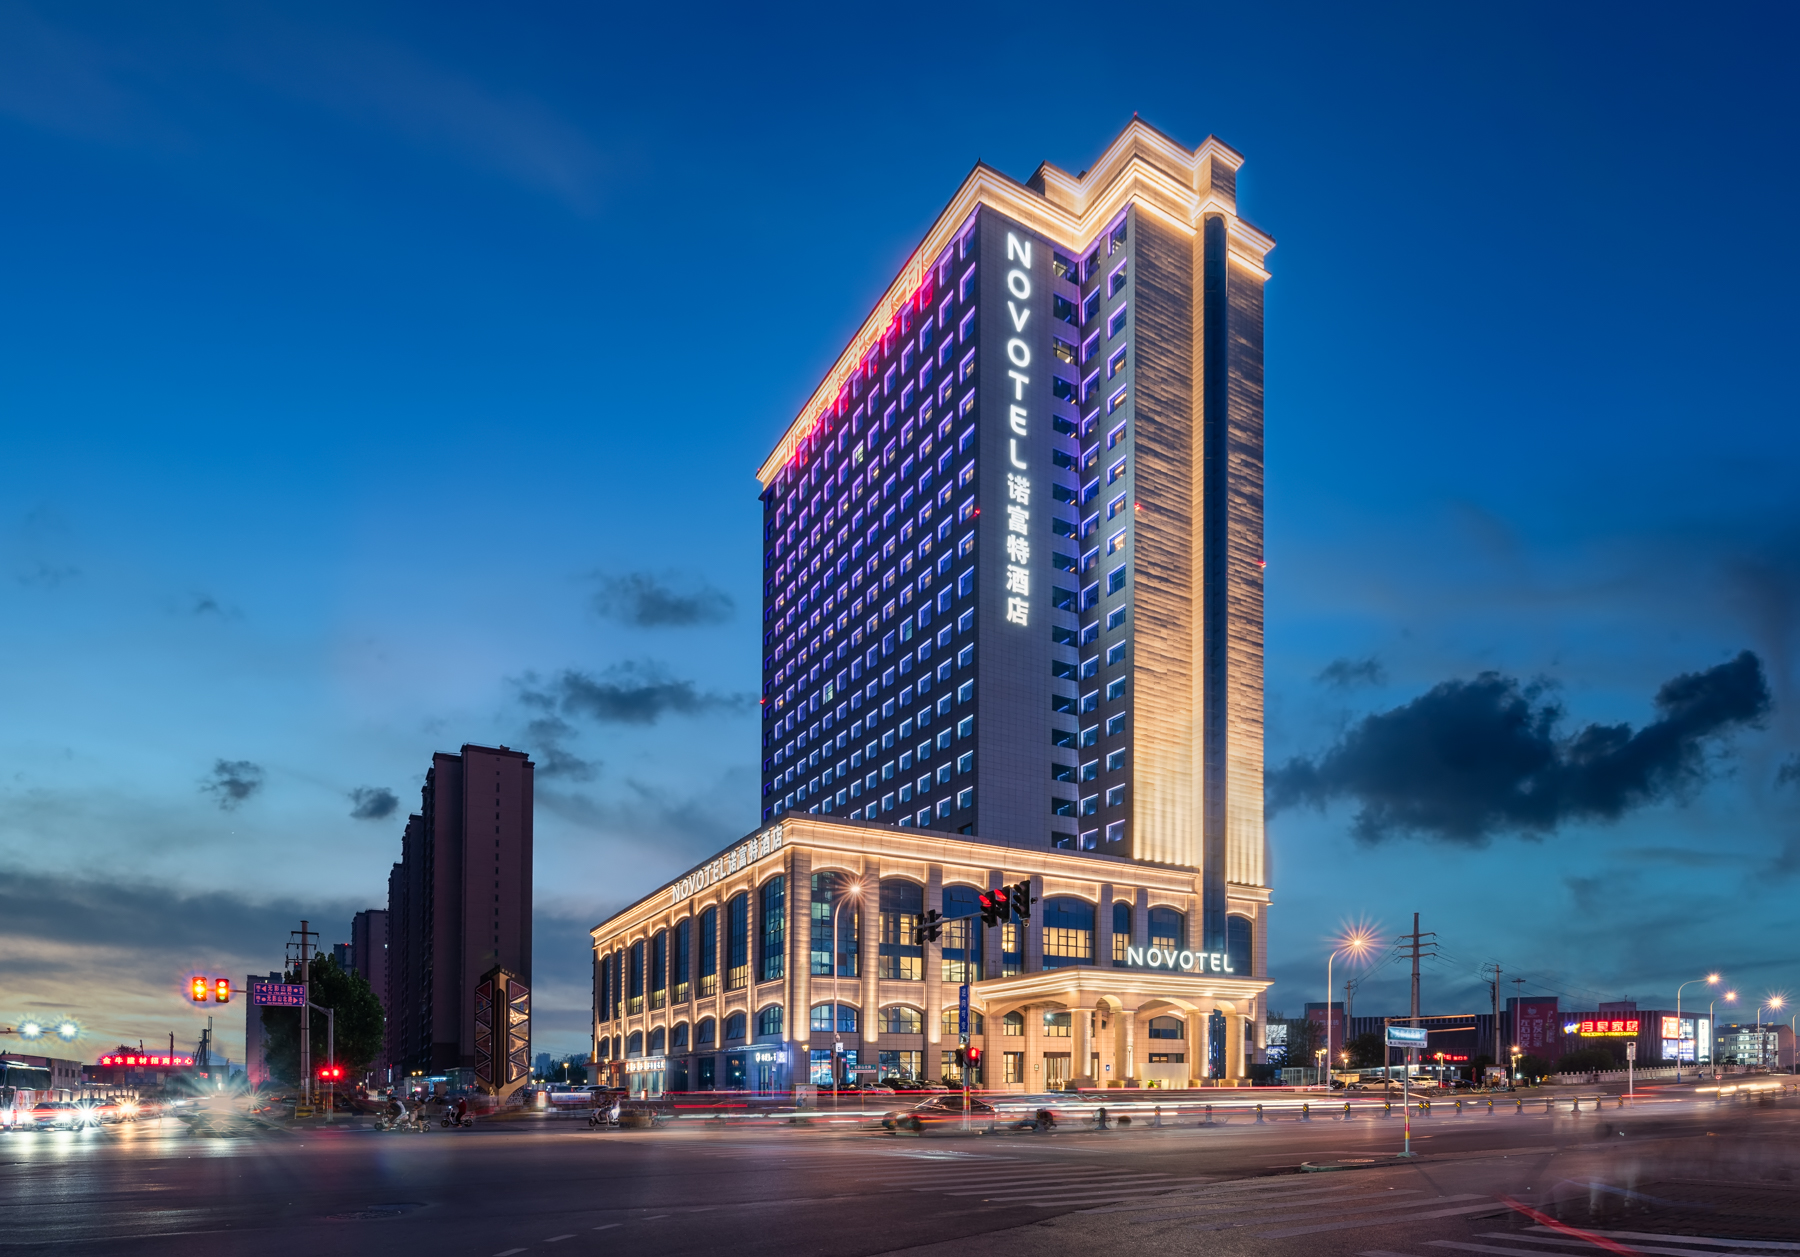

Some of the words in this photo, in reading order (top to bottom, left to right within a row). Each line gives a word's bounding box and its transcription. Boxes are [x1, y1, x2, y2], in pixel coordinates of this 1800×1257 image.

[1006, 231, 1033, 471] NOVOTEL
[1006, 473, 1031, 627] 诺富特酒店
[672, 857, 728, 905] NOVOTEL
[1127, 946, 1234, 973] NOVOTEL
[1581, 1021, 1638, 1032] 月星家居
[102, 1056, 193, 1066] 金牛建材招商中心
